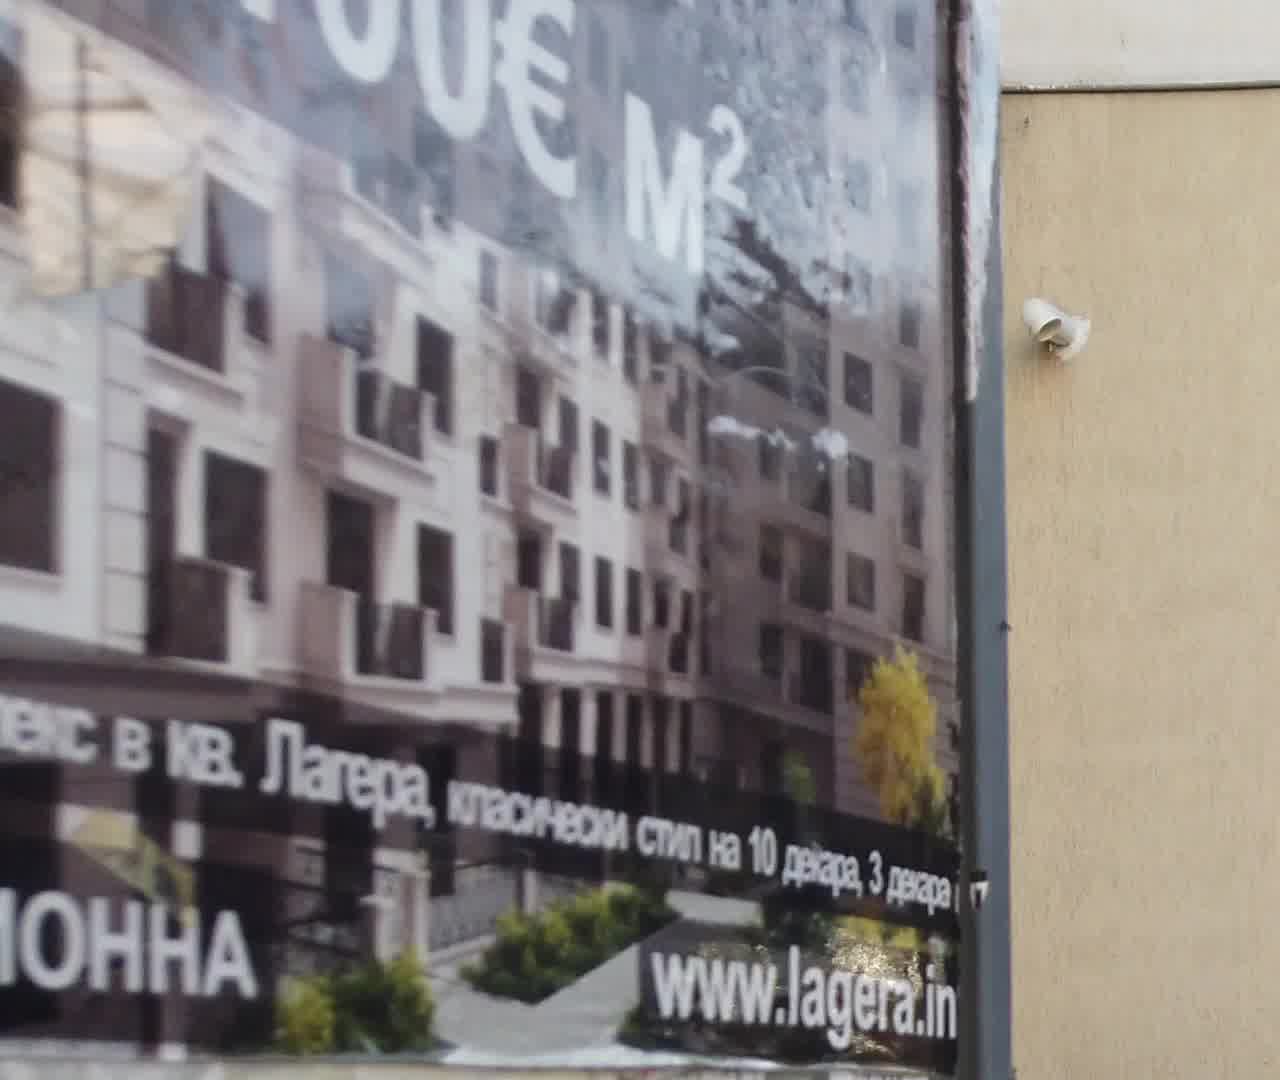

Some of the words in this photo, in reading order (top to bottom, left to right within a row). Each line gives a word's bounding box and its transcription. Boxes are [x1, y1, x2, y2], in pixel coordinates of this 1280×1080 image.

[113, 716, 152, 773] в
[165, 718, 243, 789] кв.
[259, 717, 436, 830] Лагера,
[447, 779, 631, 851] класически
[636, 814, 703, 864] стил
[708, 828, 742, 871] на
[748, 824, 777, 877] 10
[782, 843, 864, 898] декара,
[868, 849, 883, 896] 3
[886, 865, 951, 917] декара
[0, 886, 259, 1000] ОННА
[651, 944, 958, 1050] www.lagera.in
